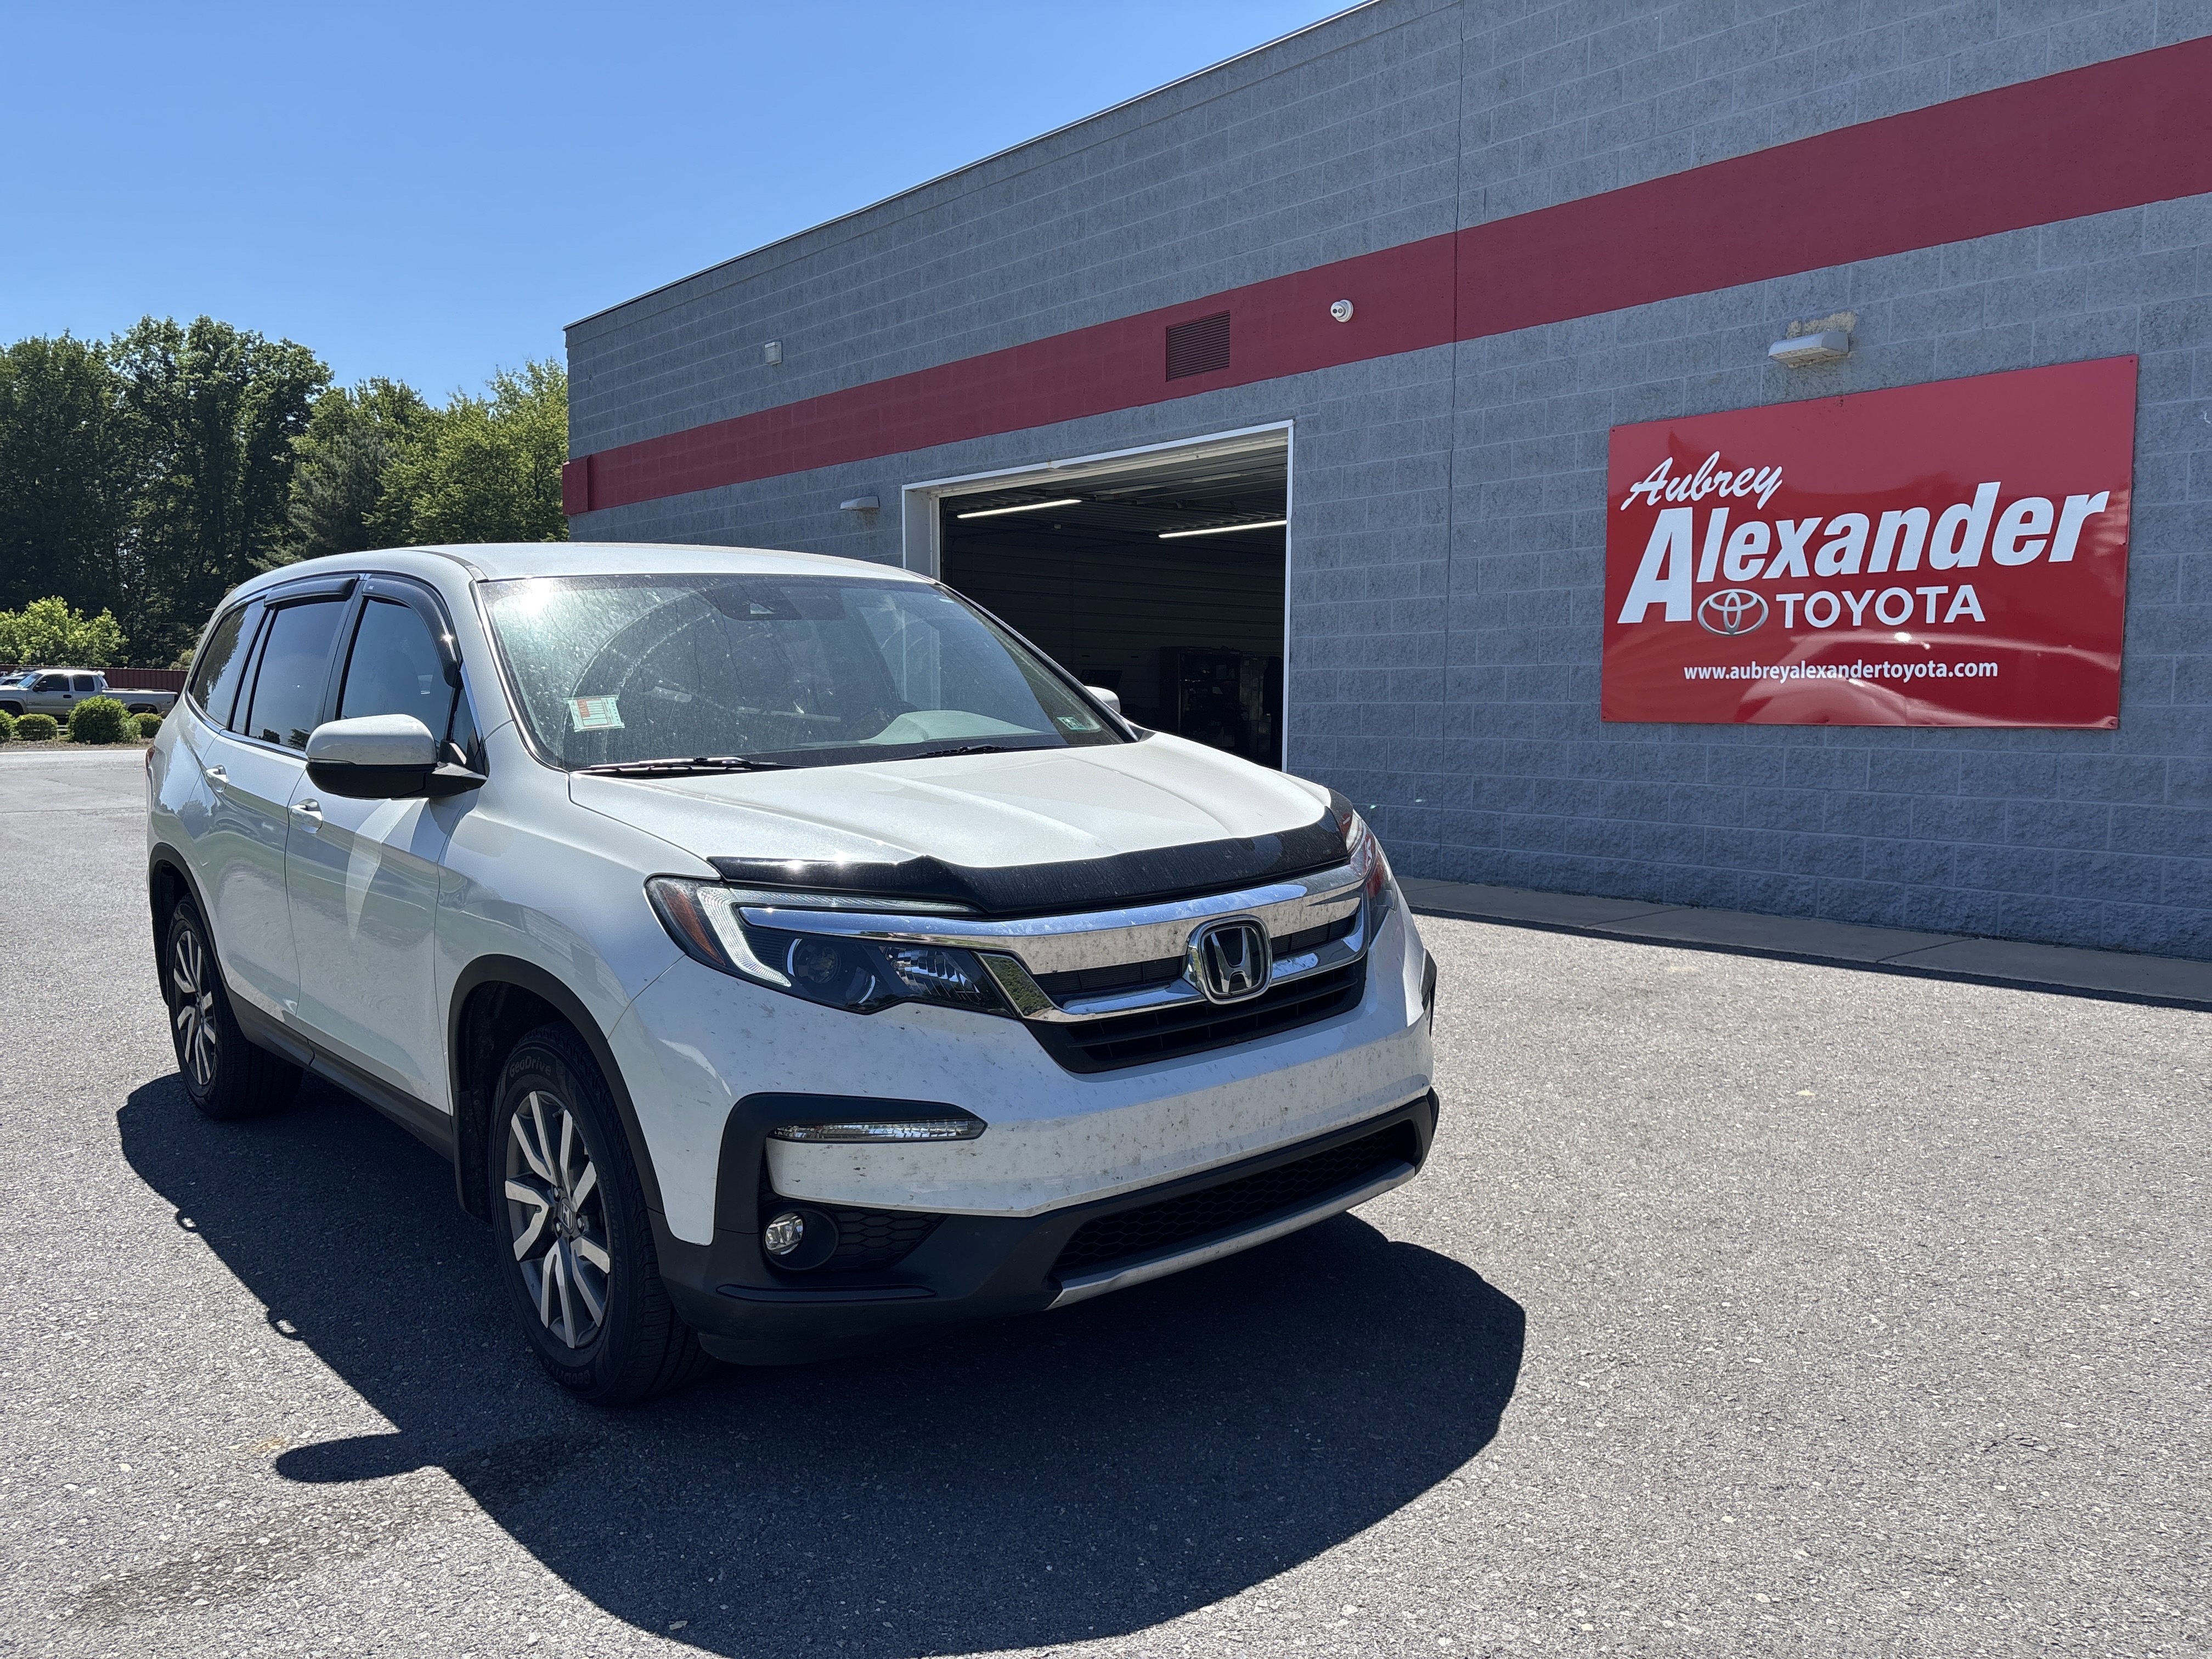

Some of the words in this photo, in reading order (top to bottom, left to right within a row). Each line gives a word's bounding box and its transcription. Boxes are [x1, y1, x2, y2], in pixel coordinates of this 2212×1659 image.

[1620, 450, 1782, 511] Aubrey
[1617, 481, 2110, 624] Alexander
[1776, 584, 1986, 629] TOYOTA
[1684, 659, 1998, 685] www.aubreyalexandertoyota.com
[509, 1056, 551, 1078] GeoDrive
